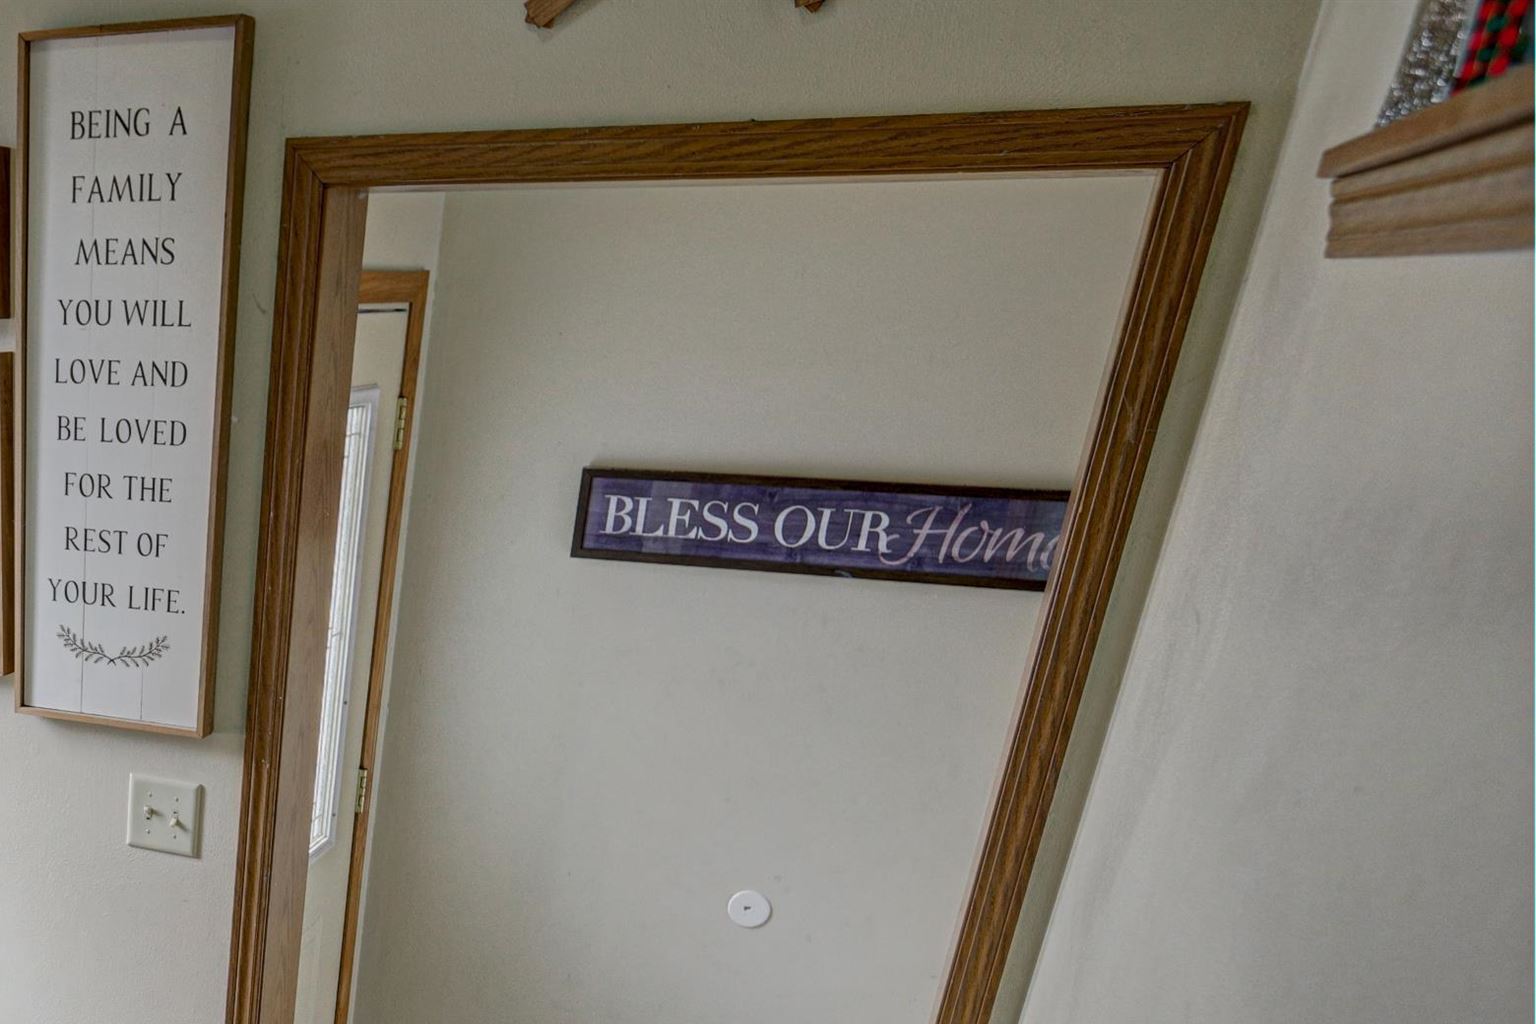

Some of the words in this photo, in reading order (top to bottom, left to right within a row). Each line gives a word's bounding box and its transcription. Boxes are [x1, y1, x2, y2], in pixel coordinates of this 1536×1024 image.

[70, 107, 150, 140] BEING
[168, 106, 188, 136] A
[71, 172, 183, 203] FAMILY
[74, 237, 176, 266] MEANS
[58, 299, 113, 326] YOU
[121, 299, 192, 328] WILL
[54, 358, 121, 386] LOVE
[130, 360, 188, 388] AND
[57, 415, 86, 442] BE
[100, 417, 187, 447] LOVED
[64, 472, 113, 499] FOR
[123, 475, 173, 503] THE
[599, 494, 760, 545] BLESS
[774, 504, 893, 554] OUR
[64, 526, 128, 555] REST
[137, 532, 169, 558] OF
[48, 578, 117, 608] YOUR
[128, 585, 186, 615] LIFE.
